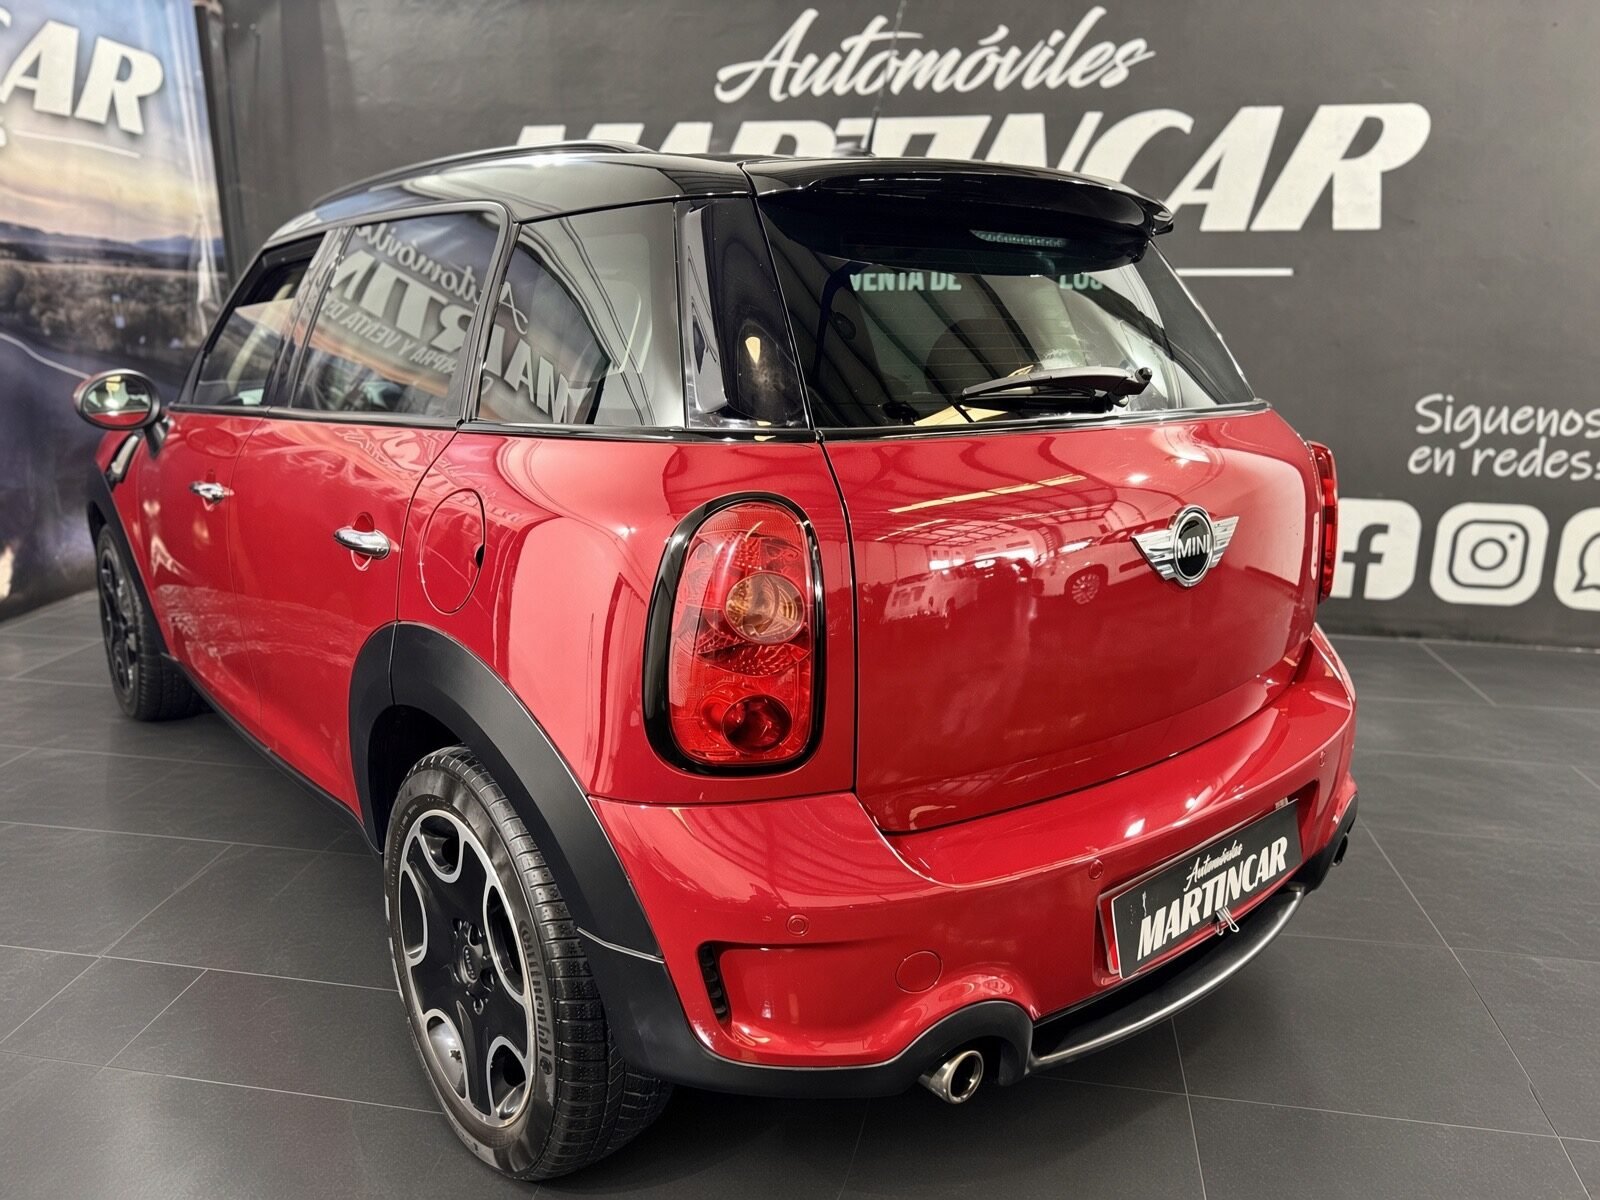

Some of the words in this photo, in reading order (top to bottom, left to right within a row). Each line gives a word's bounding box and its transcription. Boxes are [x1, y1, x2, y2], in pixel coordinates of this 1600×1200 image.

[0, 6, 163, 135] AR
[715, 7, 1155, 102] Automóviles
[513, 102, 1431, 231] TNCAR
[1407, 445, 1455, 477] en
[1177, 534, 1211, 559] MINI
[1136, 836, 1288, 961] MARTINCAR
